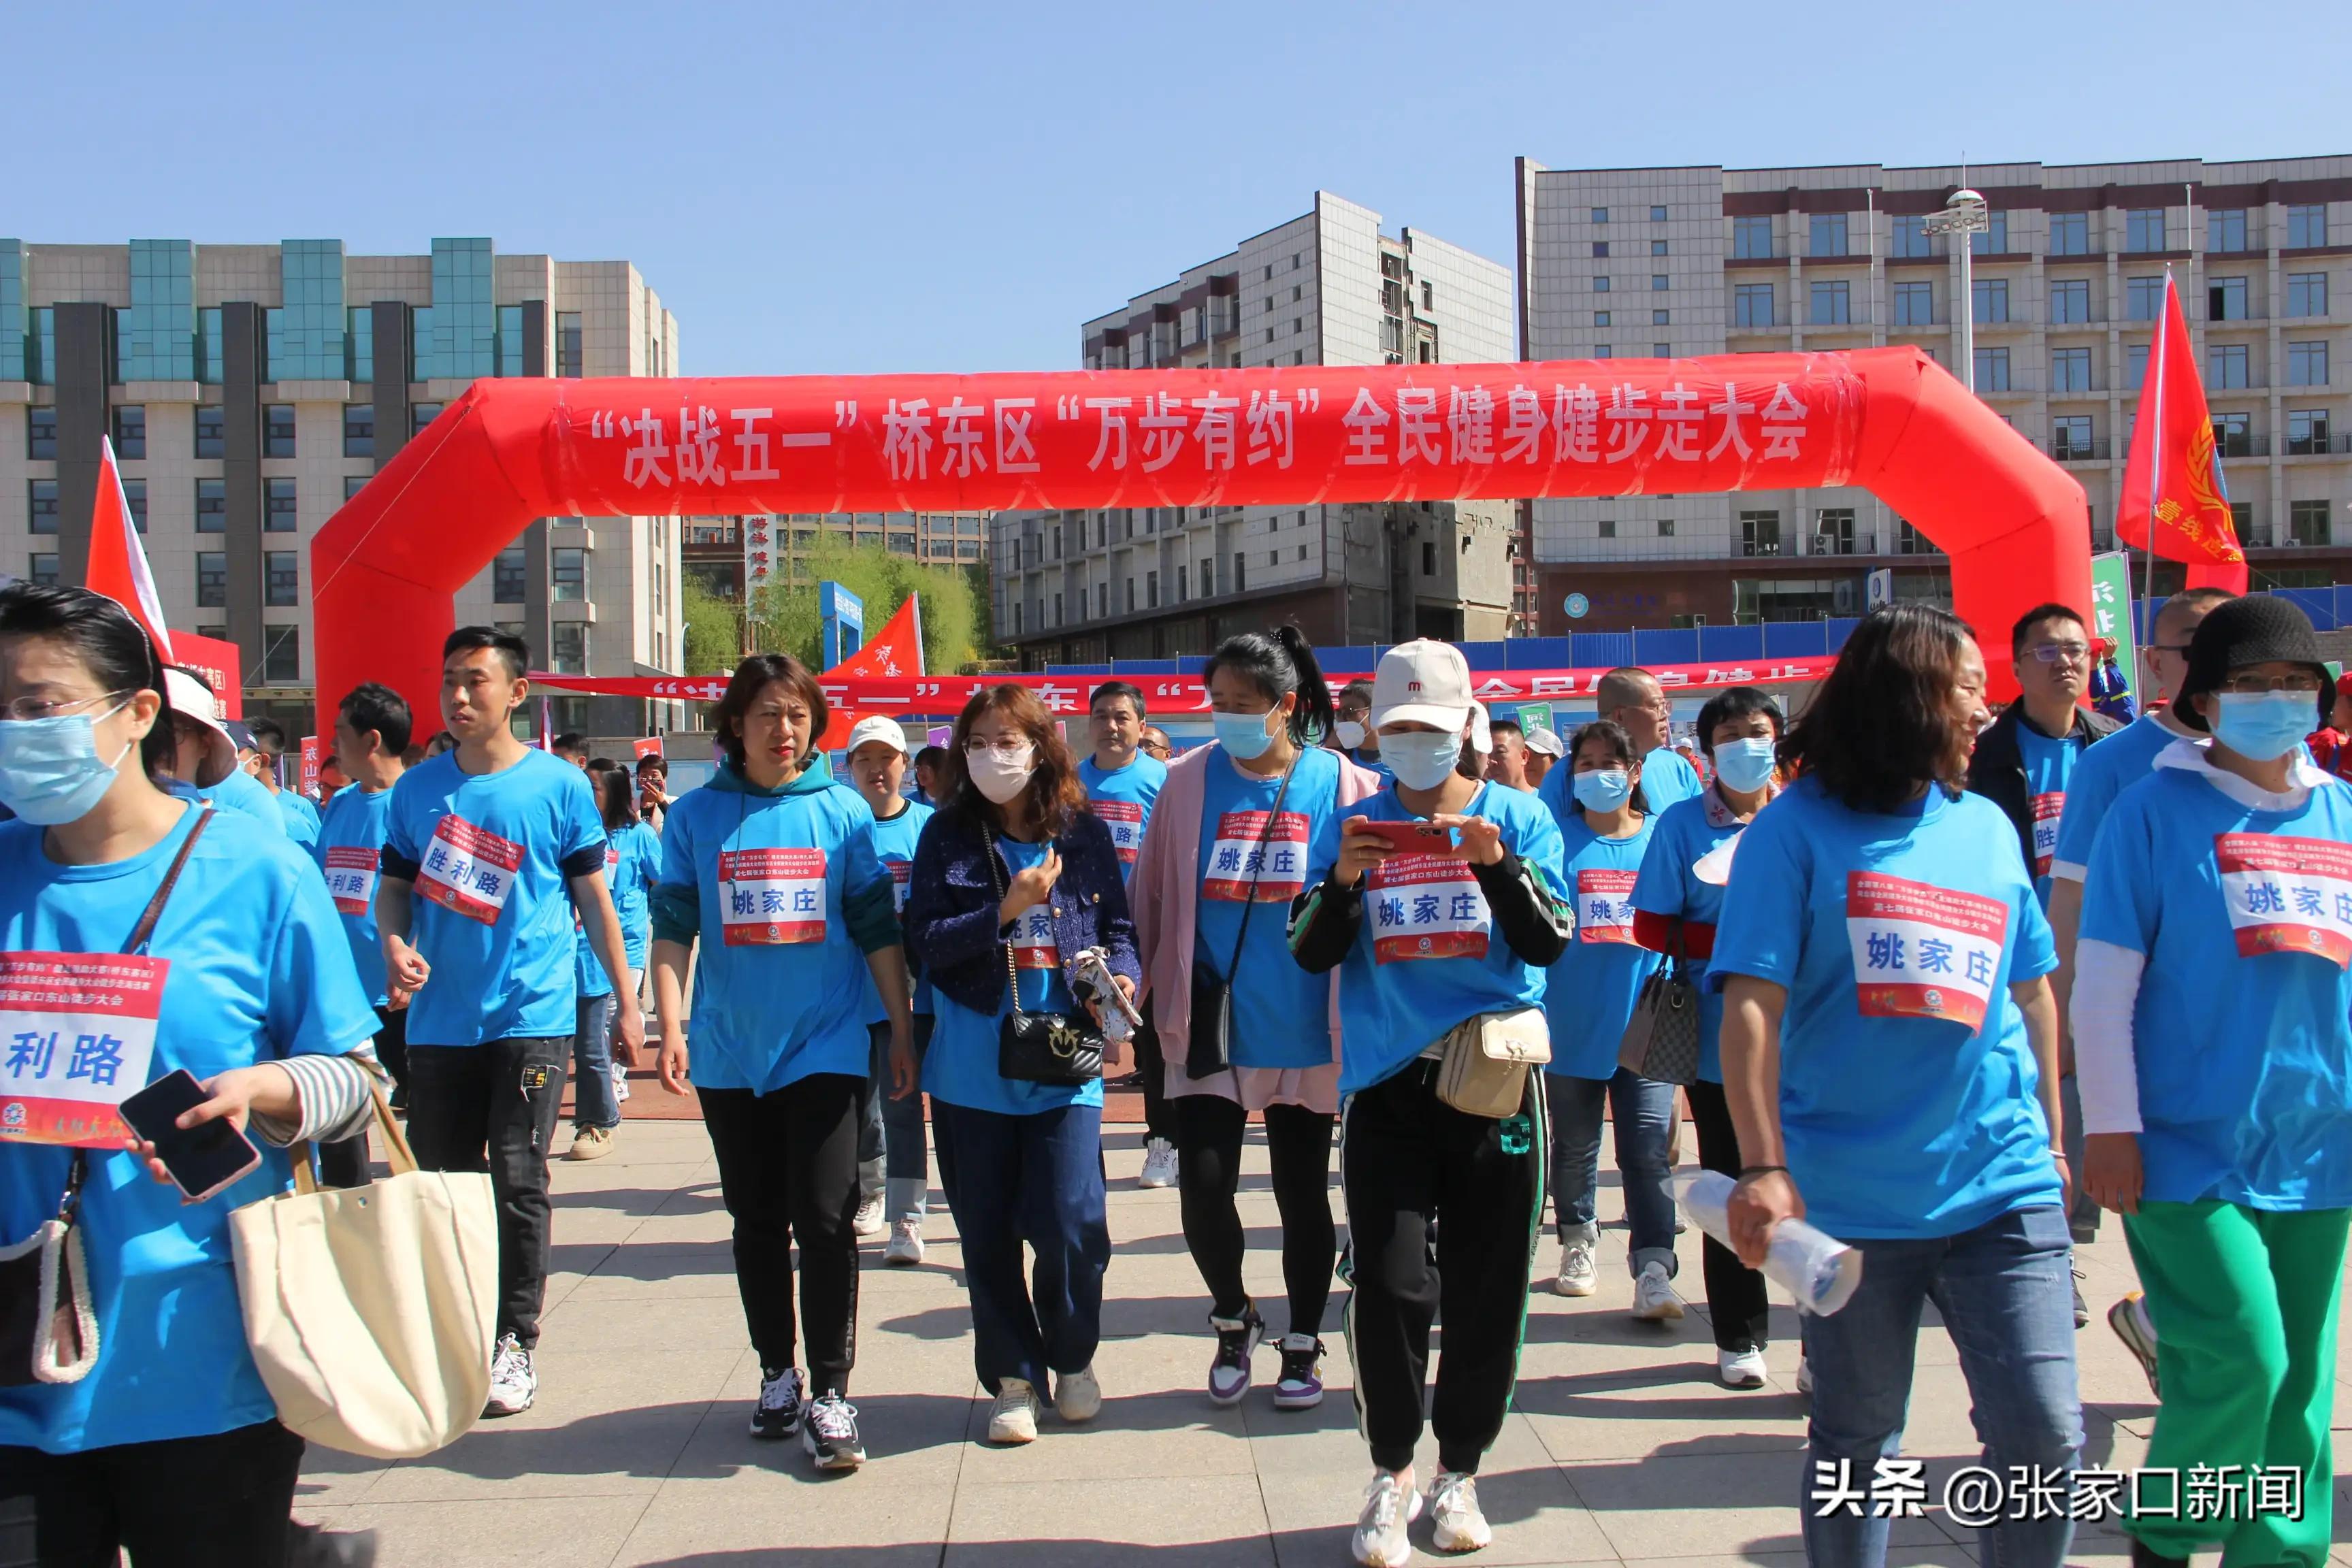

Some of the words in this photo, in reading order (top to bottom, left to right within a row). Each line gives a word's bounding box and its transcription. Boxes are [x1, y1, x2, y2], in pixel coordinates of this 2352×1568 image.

[426, 846, 501, 897] 胜利路
[1217, 847, 1296, 874] 姚家庄
[731, 888, 818, 915] 姚家庄
[1378, 892, 1478, 927] 姚家庄
[1867, 932, 1993, 989] 姚家庄
[5, 1030, 124, 1086] 利路
